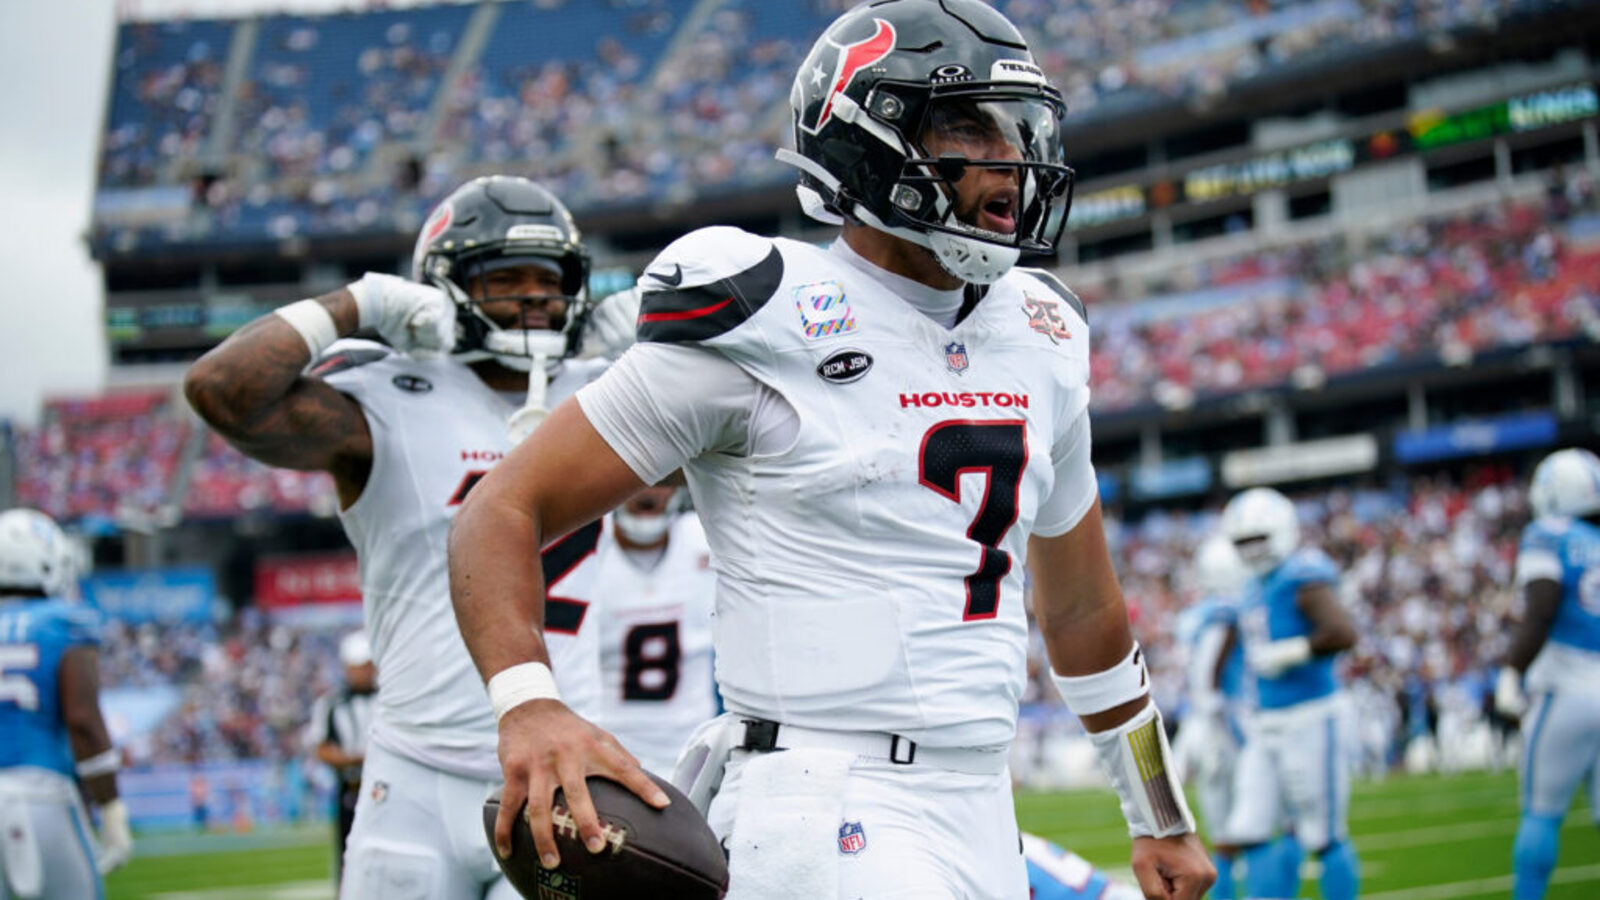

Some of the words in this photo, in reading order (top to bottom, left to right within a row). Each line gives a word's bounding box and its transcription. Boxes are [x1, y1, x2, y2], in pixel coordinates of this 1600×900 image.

[823, 361, 846, 376] RCM
[849, 356, 868, 370] JSM
[899, 392, 1029, 409] HOUSTON
[919, 419, 1030, 622] 7
[620, 620, 681, 701] 8
[841, 834, 863, 850] NFL
